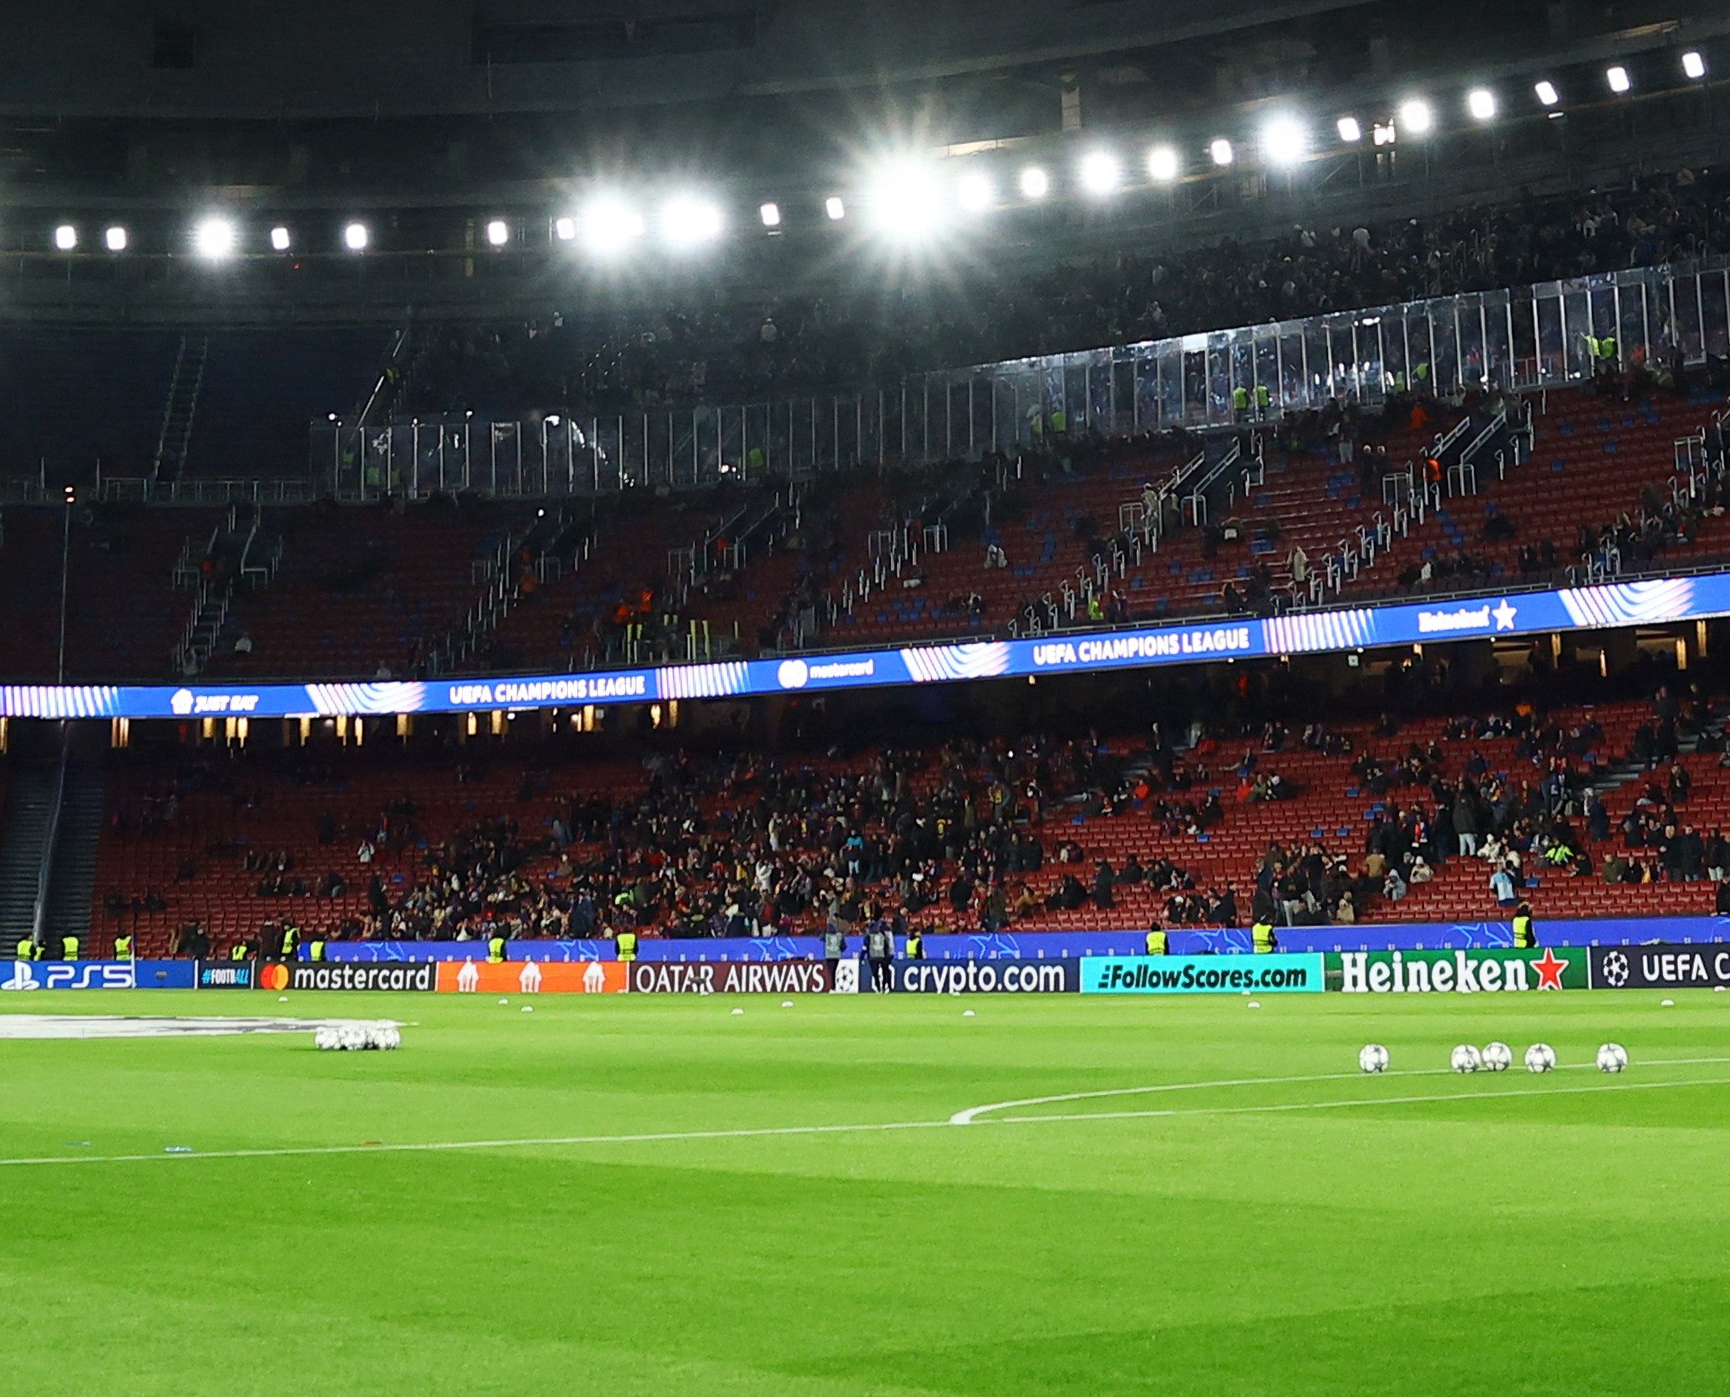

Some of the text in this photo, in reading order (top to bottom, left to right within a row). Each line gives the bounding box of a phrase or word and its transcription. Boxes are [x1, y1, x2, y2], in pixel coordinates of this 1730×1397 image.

[1033, 627, 1250, 666] UEFA CHAMPIONS LEAGUE
[450, 675, 646, 704] UEFA CHAMPIONS LEAGUE
[46, 965, 132, 989] PS5
[294, 964, 429, 991] mastercard
[635, 964, 824, 993] QATAR AIRWAYS
[903, 959, 1065, 994] crypto.com
[1341, 950, 1529, 993] Heineken
[1642, 954, 1708, 982] UEFA
